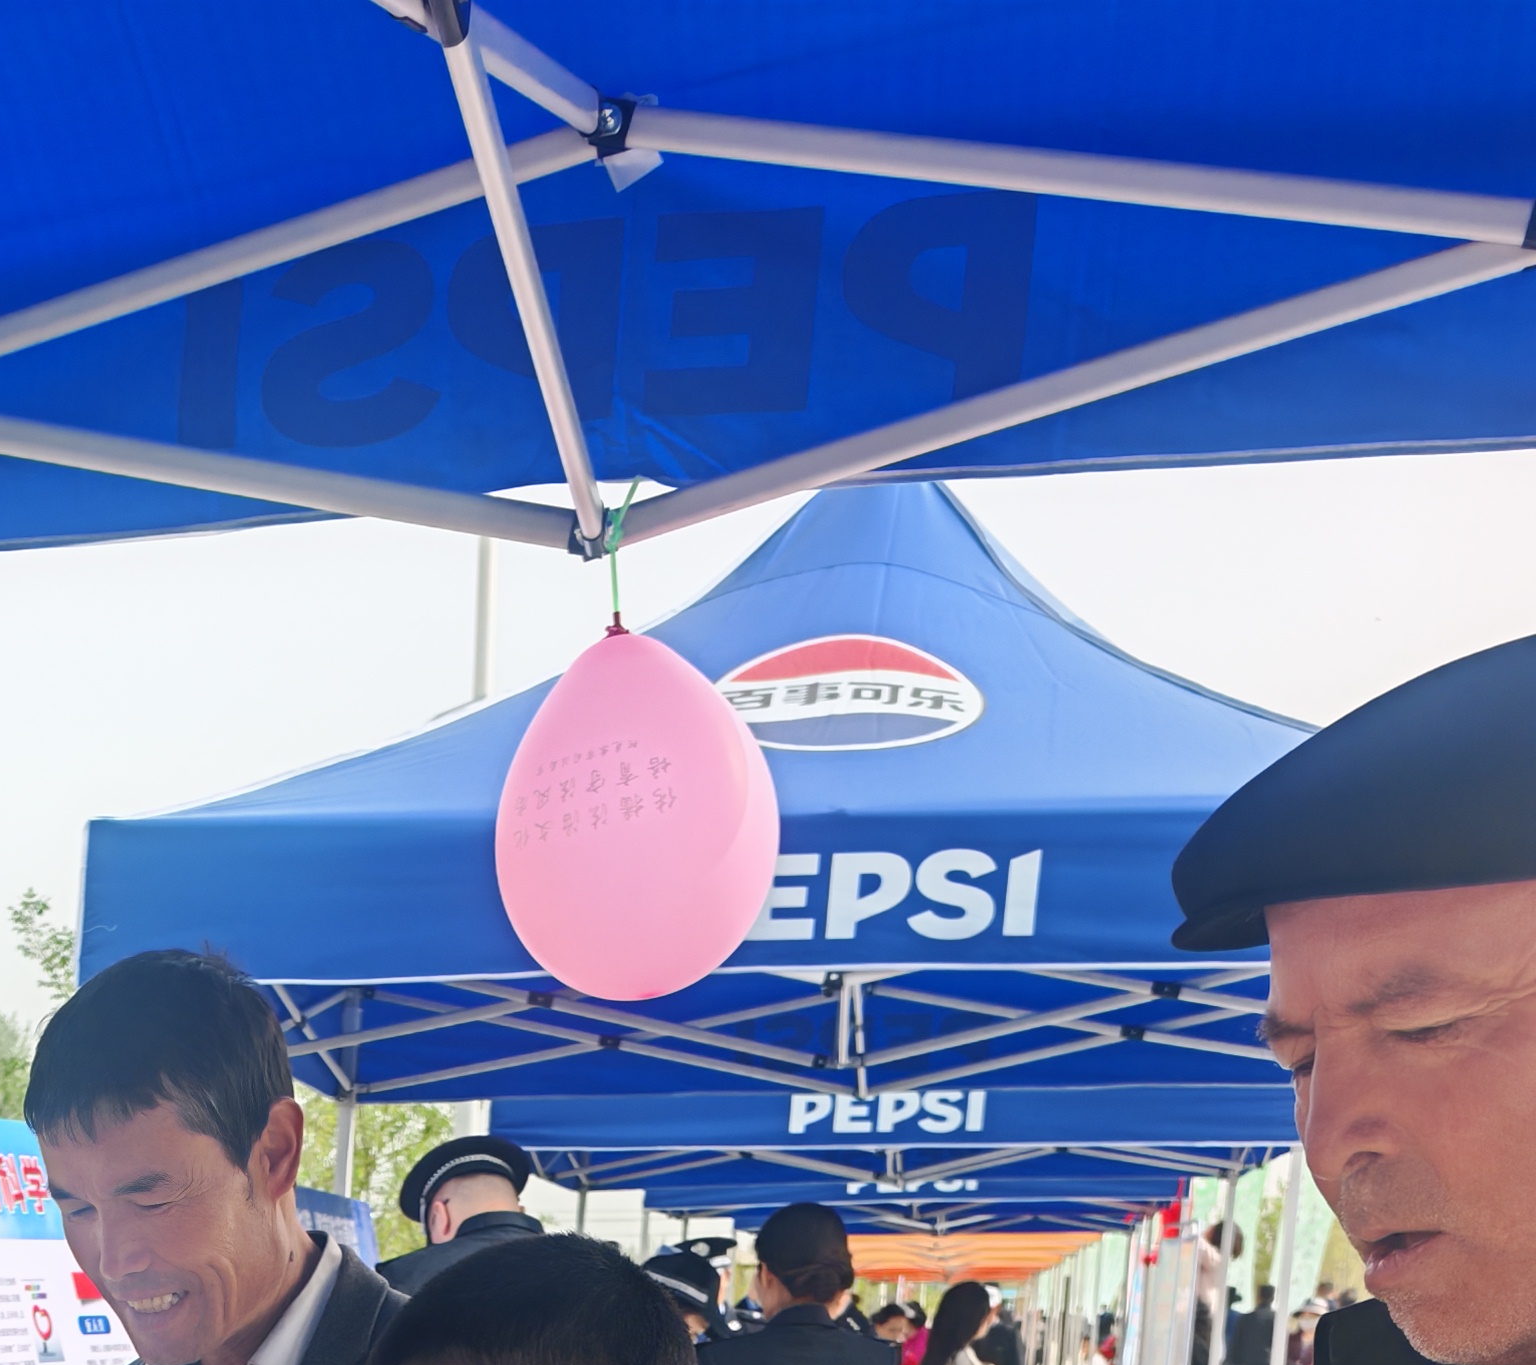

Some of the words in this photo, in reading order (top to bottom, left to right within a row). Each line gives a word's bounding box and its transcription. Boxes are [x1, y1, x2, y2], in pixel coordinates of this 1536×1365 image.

[723, 681, 967, 716] 百事可乐
[748, 850, 1043, 939] EPSI
[788, 1090, 987, 1134] PEPSI
